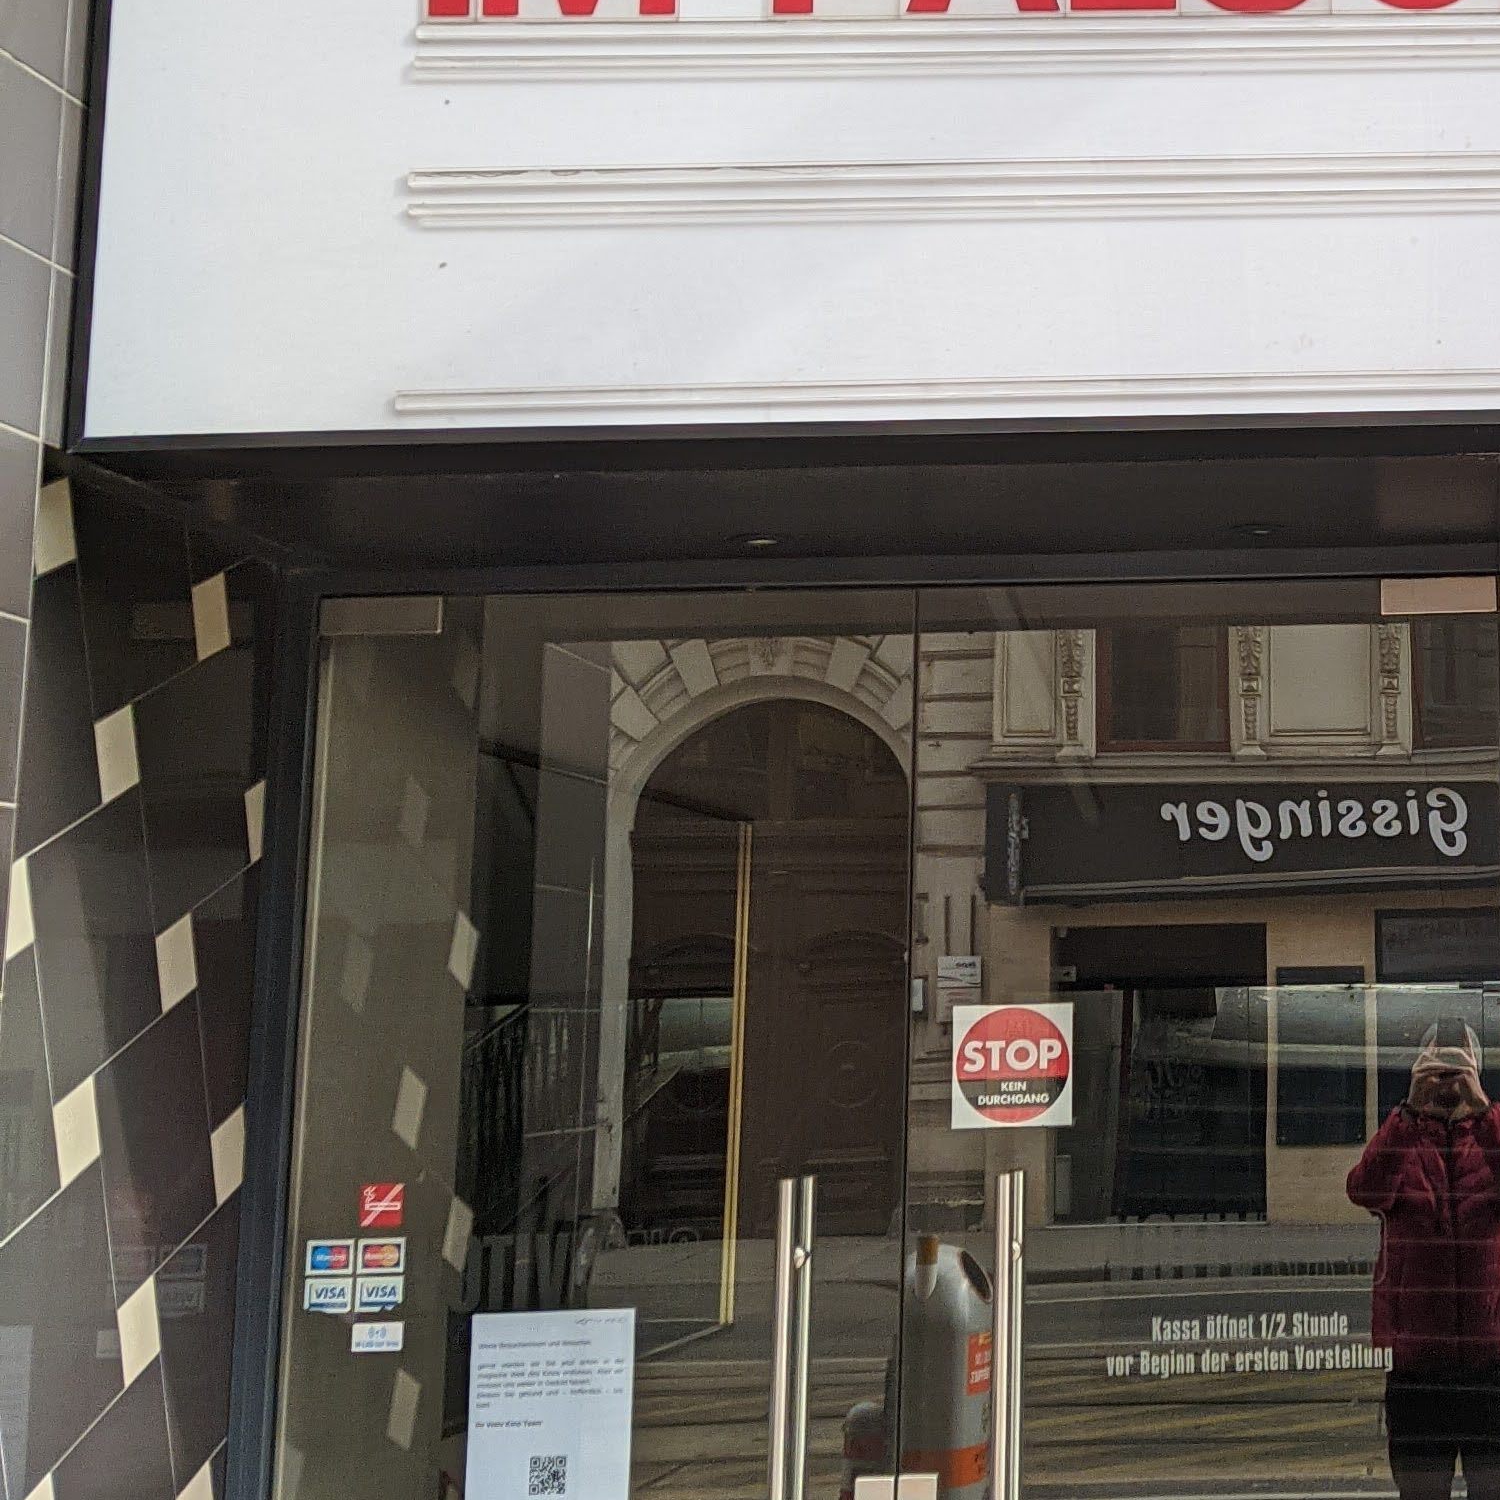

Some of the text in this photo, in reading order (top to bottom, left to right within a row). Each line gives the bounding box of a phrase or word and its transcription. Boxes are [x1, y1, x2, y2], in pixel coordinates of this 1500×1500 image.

[963, 1038, 1062, 1073] STOP
[1000, 1080, 1027, 1092] KEIN
[977, 1093, 1050, 1106] DURCHGANG
[315, 1287, 346, 1300] VISA
[366, 1286, 397, 1298] VISA
[1152, 1311, 1348, 1342] Kassa öffnet 1/2 Stunde
[1106, 1344, 1394, 1379] vor Beginn der ersten Vorstellung
